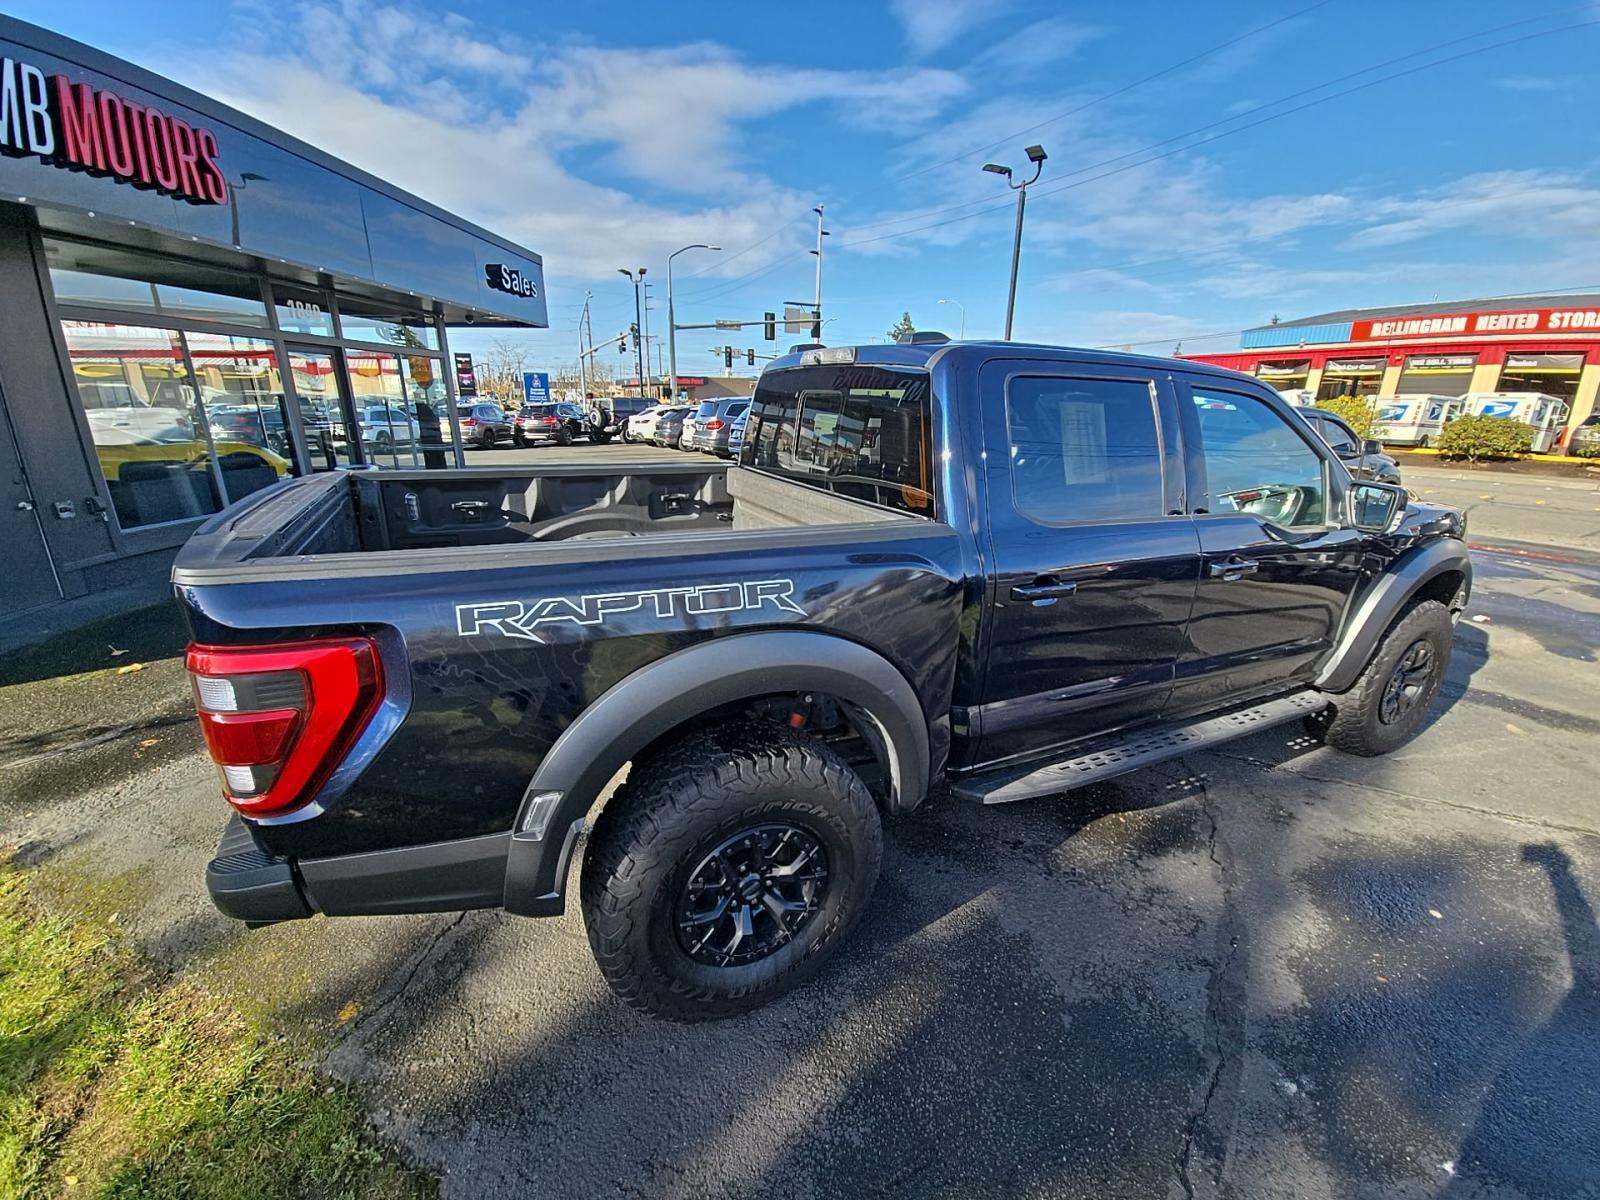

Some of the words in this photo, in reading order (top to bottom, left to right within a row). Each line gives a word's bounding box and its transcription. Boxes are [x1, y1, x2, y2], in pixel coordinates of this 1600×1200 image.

[56, 74, 228, 205] MOTORS
[501, 264, 538, 298] Sales
[1369, 317, 1467, 337] BELLINGHAM
[1475, 313, 1539, 332] HEATED
[455, 579, 809, 645] RAPTOR
